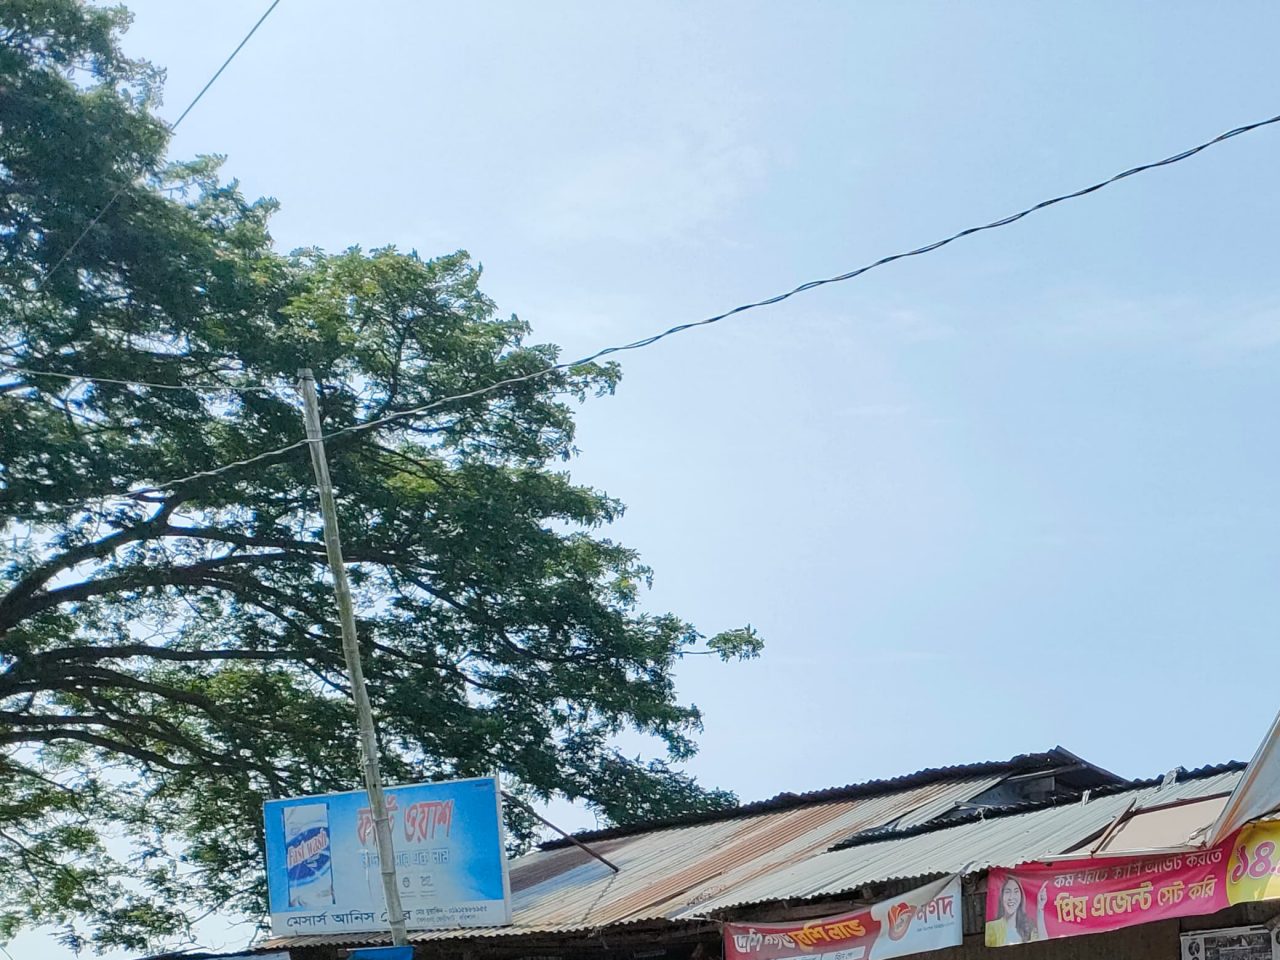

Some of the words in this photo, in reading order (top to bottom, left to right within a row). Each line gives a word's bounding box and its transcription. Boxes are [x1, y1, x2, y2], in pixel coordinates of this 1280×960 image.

[404, 799, 454, 843] ওয়াশ
[1054, 875, 1074, 888] কম
[1144, 854, 1182, 873] আউট
[1186, 849, 1223, 868] করতে
[287, 910, 328, 927] মেসার্স
[332, 909, 376, 925] আনিস
[917, 895, 954, 923] নগদ
[1054, 892, 1089, 923] প্রিয়
[1091, 881, 1154, 916] এজেন্ট
[1157, 881, 1185, 906] সেট
[1188, 875, 1218, 900] করি
